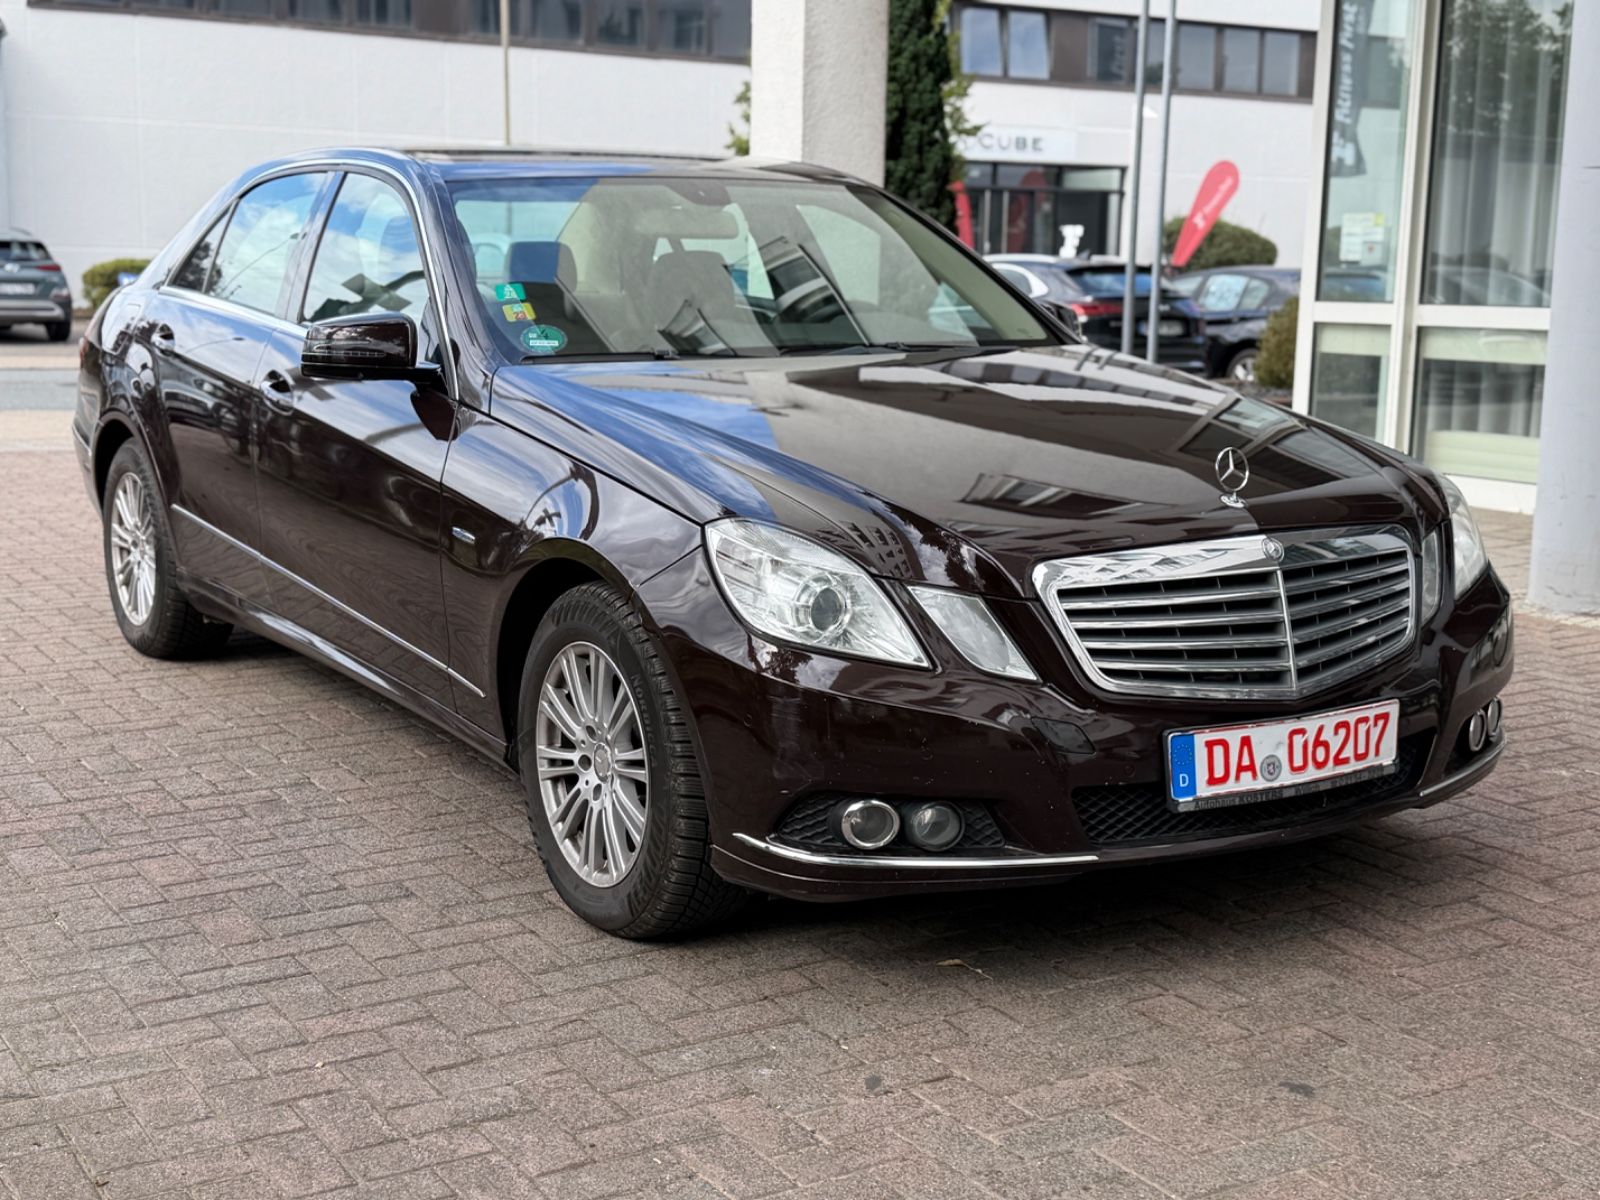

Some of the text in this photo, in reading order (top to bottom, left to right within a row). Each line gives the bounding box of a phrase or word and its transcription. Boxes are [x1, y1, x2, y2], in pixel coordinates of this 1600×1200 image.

[978, 133, 1044, 152] CUBE
[1204, 712, 1390, 786] DA 06207
[1179, 774, 1189, 788] D
